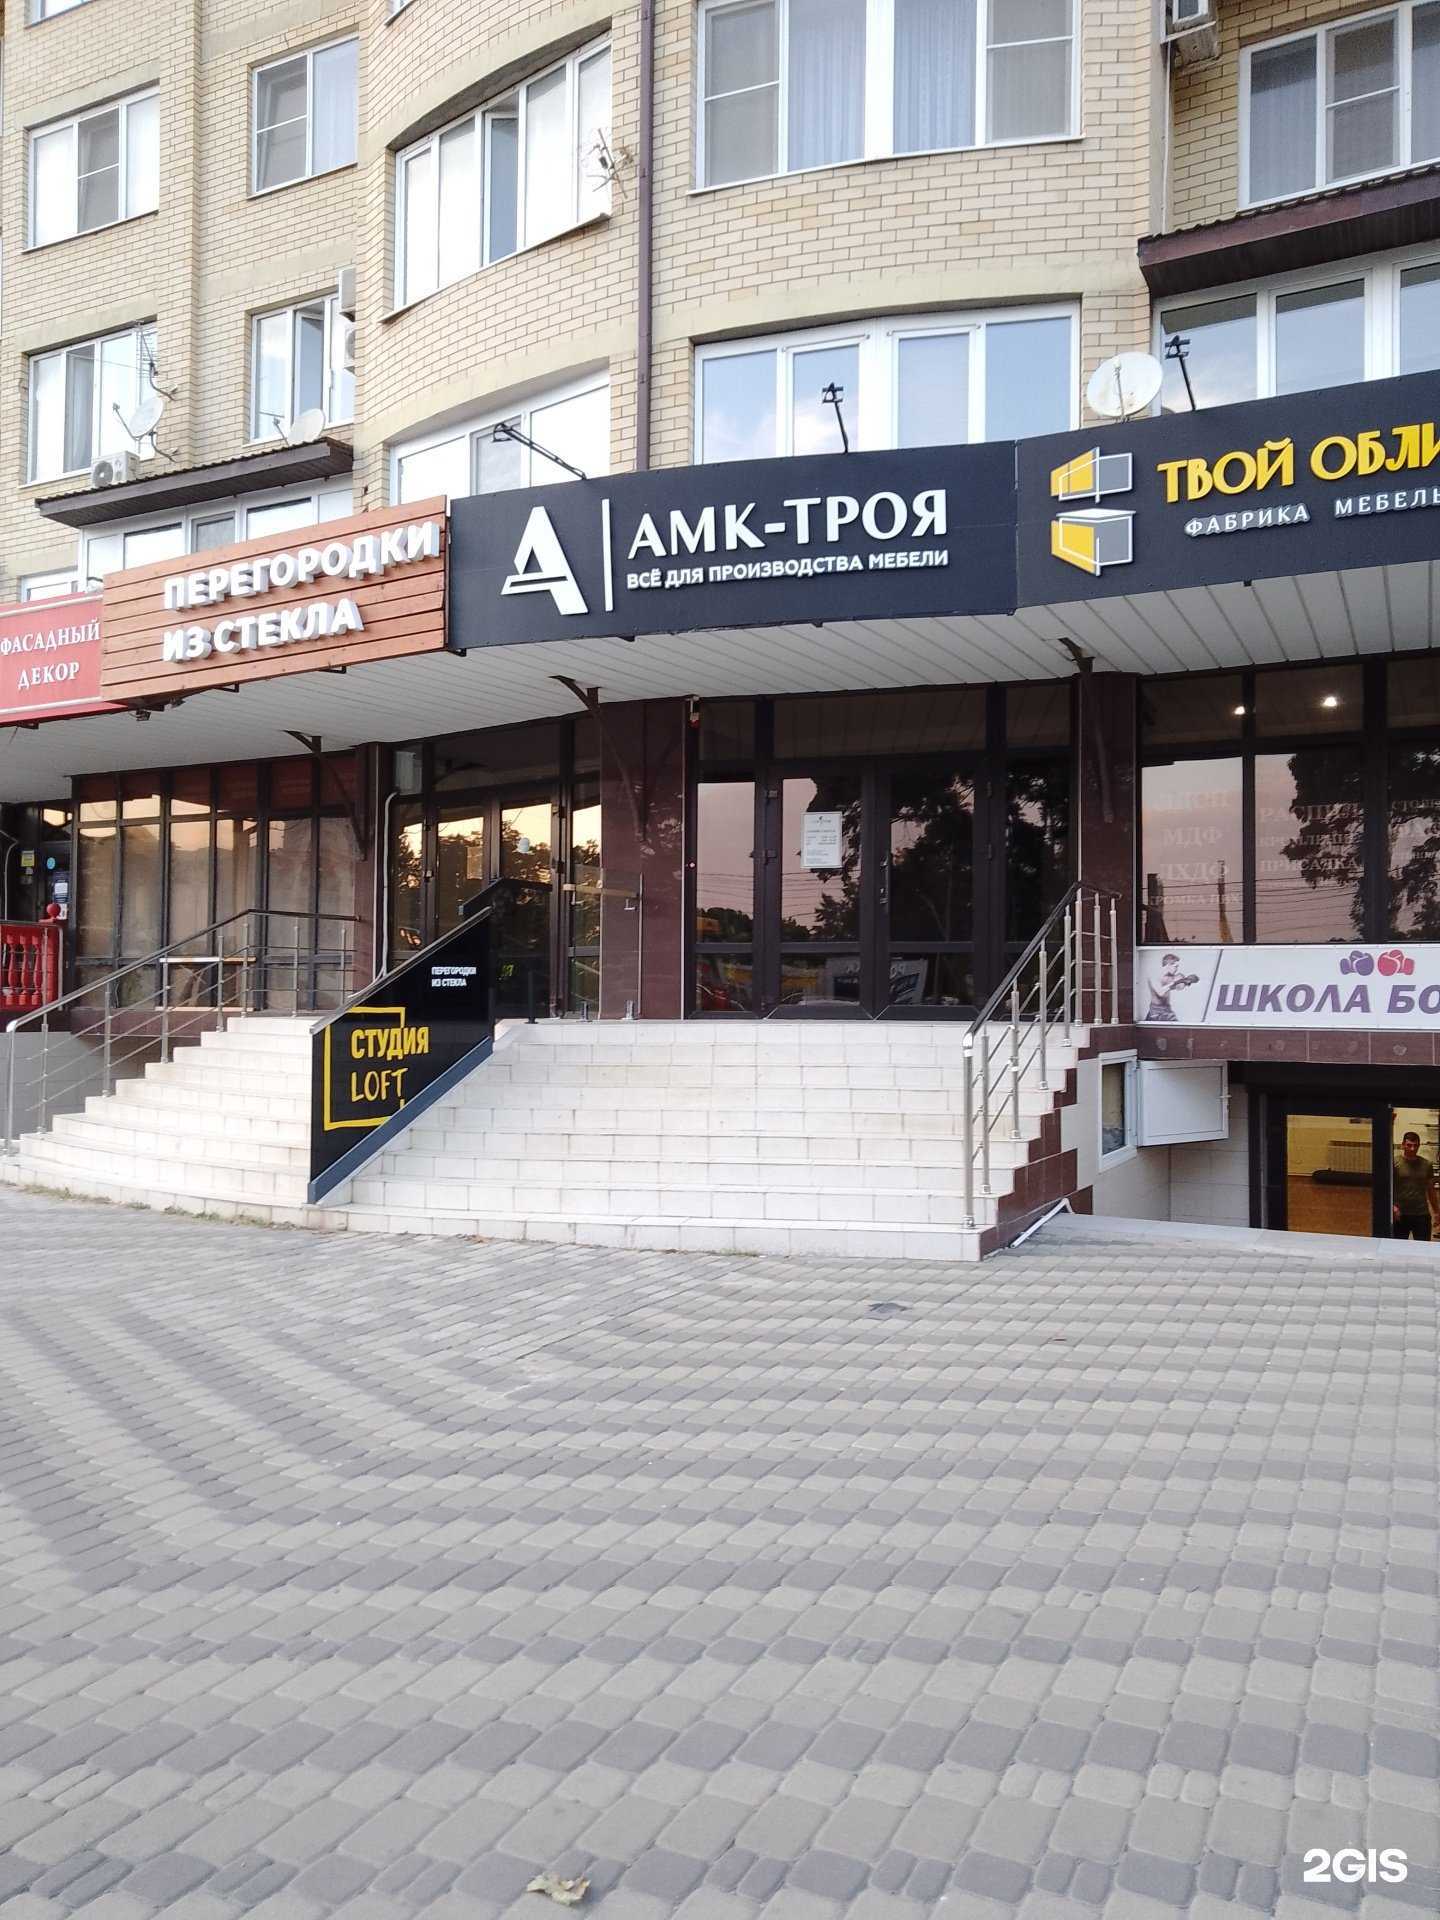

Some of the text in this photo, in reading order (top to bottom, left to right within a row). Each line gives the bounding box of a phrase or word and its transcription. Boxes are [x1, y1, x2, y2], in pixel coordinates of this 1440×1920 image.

[1157, 437, 1294, 503] ТВОЙ
[627, 489, 948, 559] АМК-ТРОЯ
[1185, 503, 1309, 536] ФАБРИКА
[163, 521, 441, 612] ПЕРЕГОРОДКИ
[627, 550, 949, 590] ВСЁ ДЛЯ ПРОИЗВОДСТВА МЕБЕЛИ
[0, 617, 100, 656] ФАСАДНЫЙ
[162, 598, 364, 663] ИЗ СТЕКЛА
[17, 661, 80, 690] ДЕКОР
[1161, 825, 1223, 849] МДФ
[1216, 984, 1372, 1013] ШКОЛА
[351, 1026, 429, 1061] СТУДИЯ
[351, 1068, 408, 1103] LOFT
